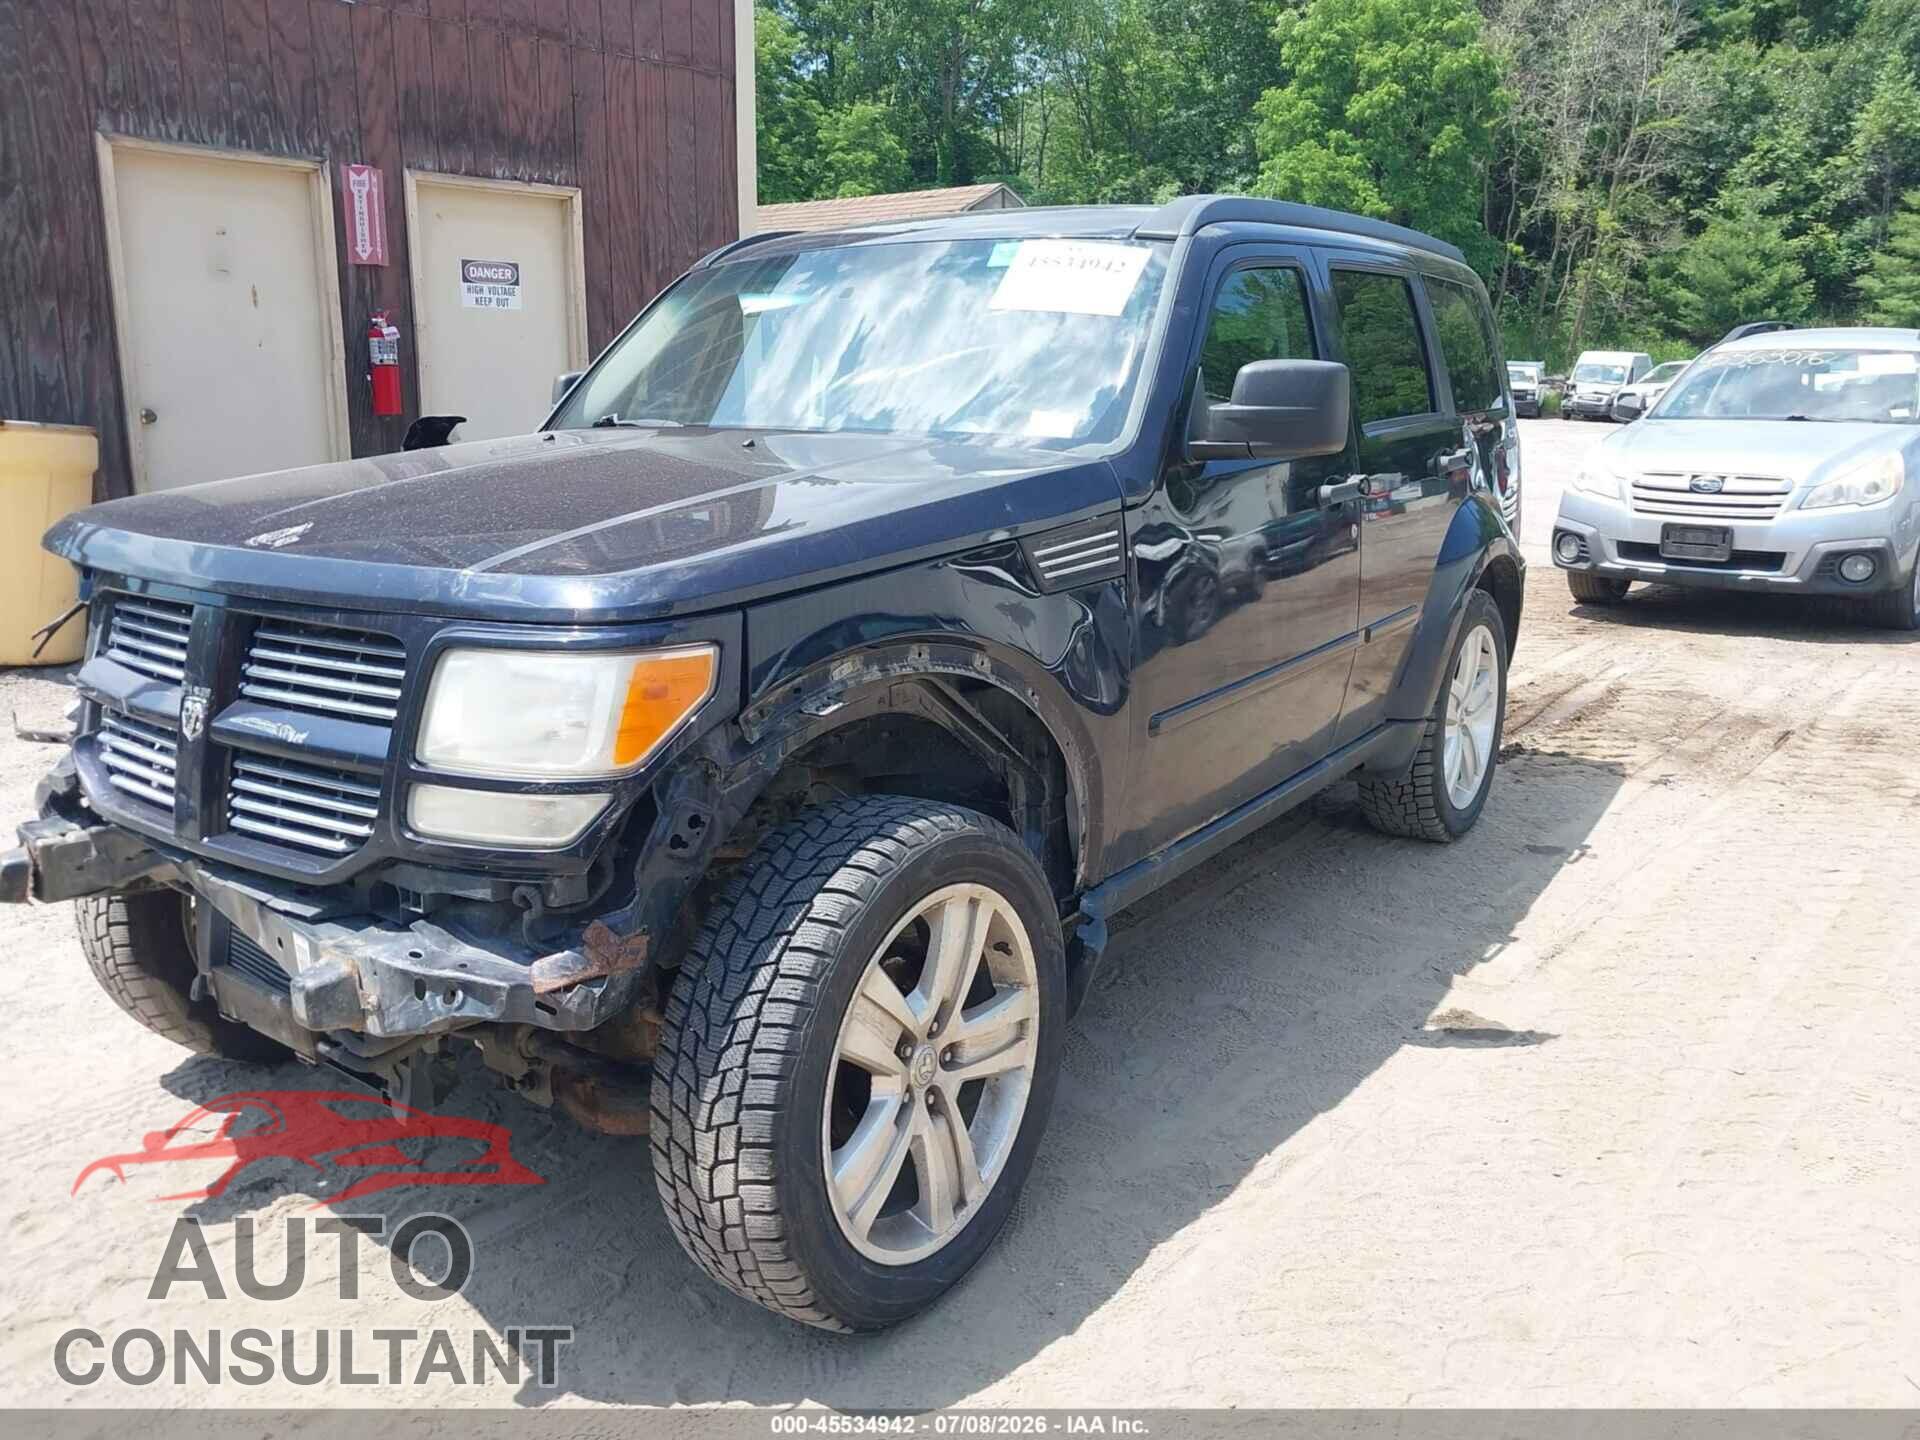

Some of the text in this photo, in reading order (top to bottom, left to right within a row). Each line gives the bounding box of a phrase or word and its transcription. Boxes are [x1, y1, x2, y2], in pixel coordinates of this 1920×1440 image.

[469, 266, 512, 280] DANGER
[466, 284, 516, 297] HIGH VOLTAGE
[475, 296, 510, 308] KEEP OUT
